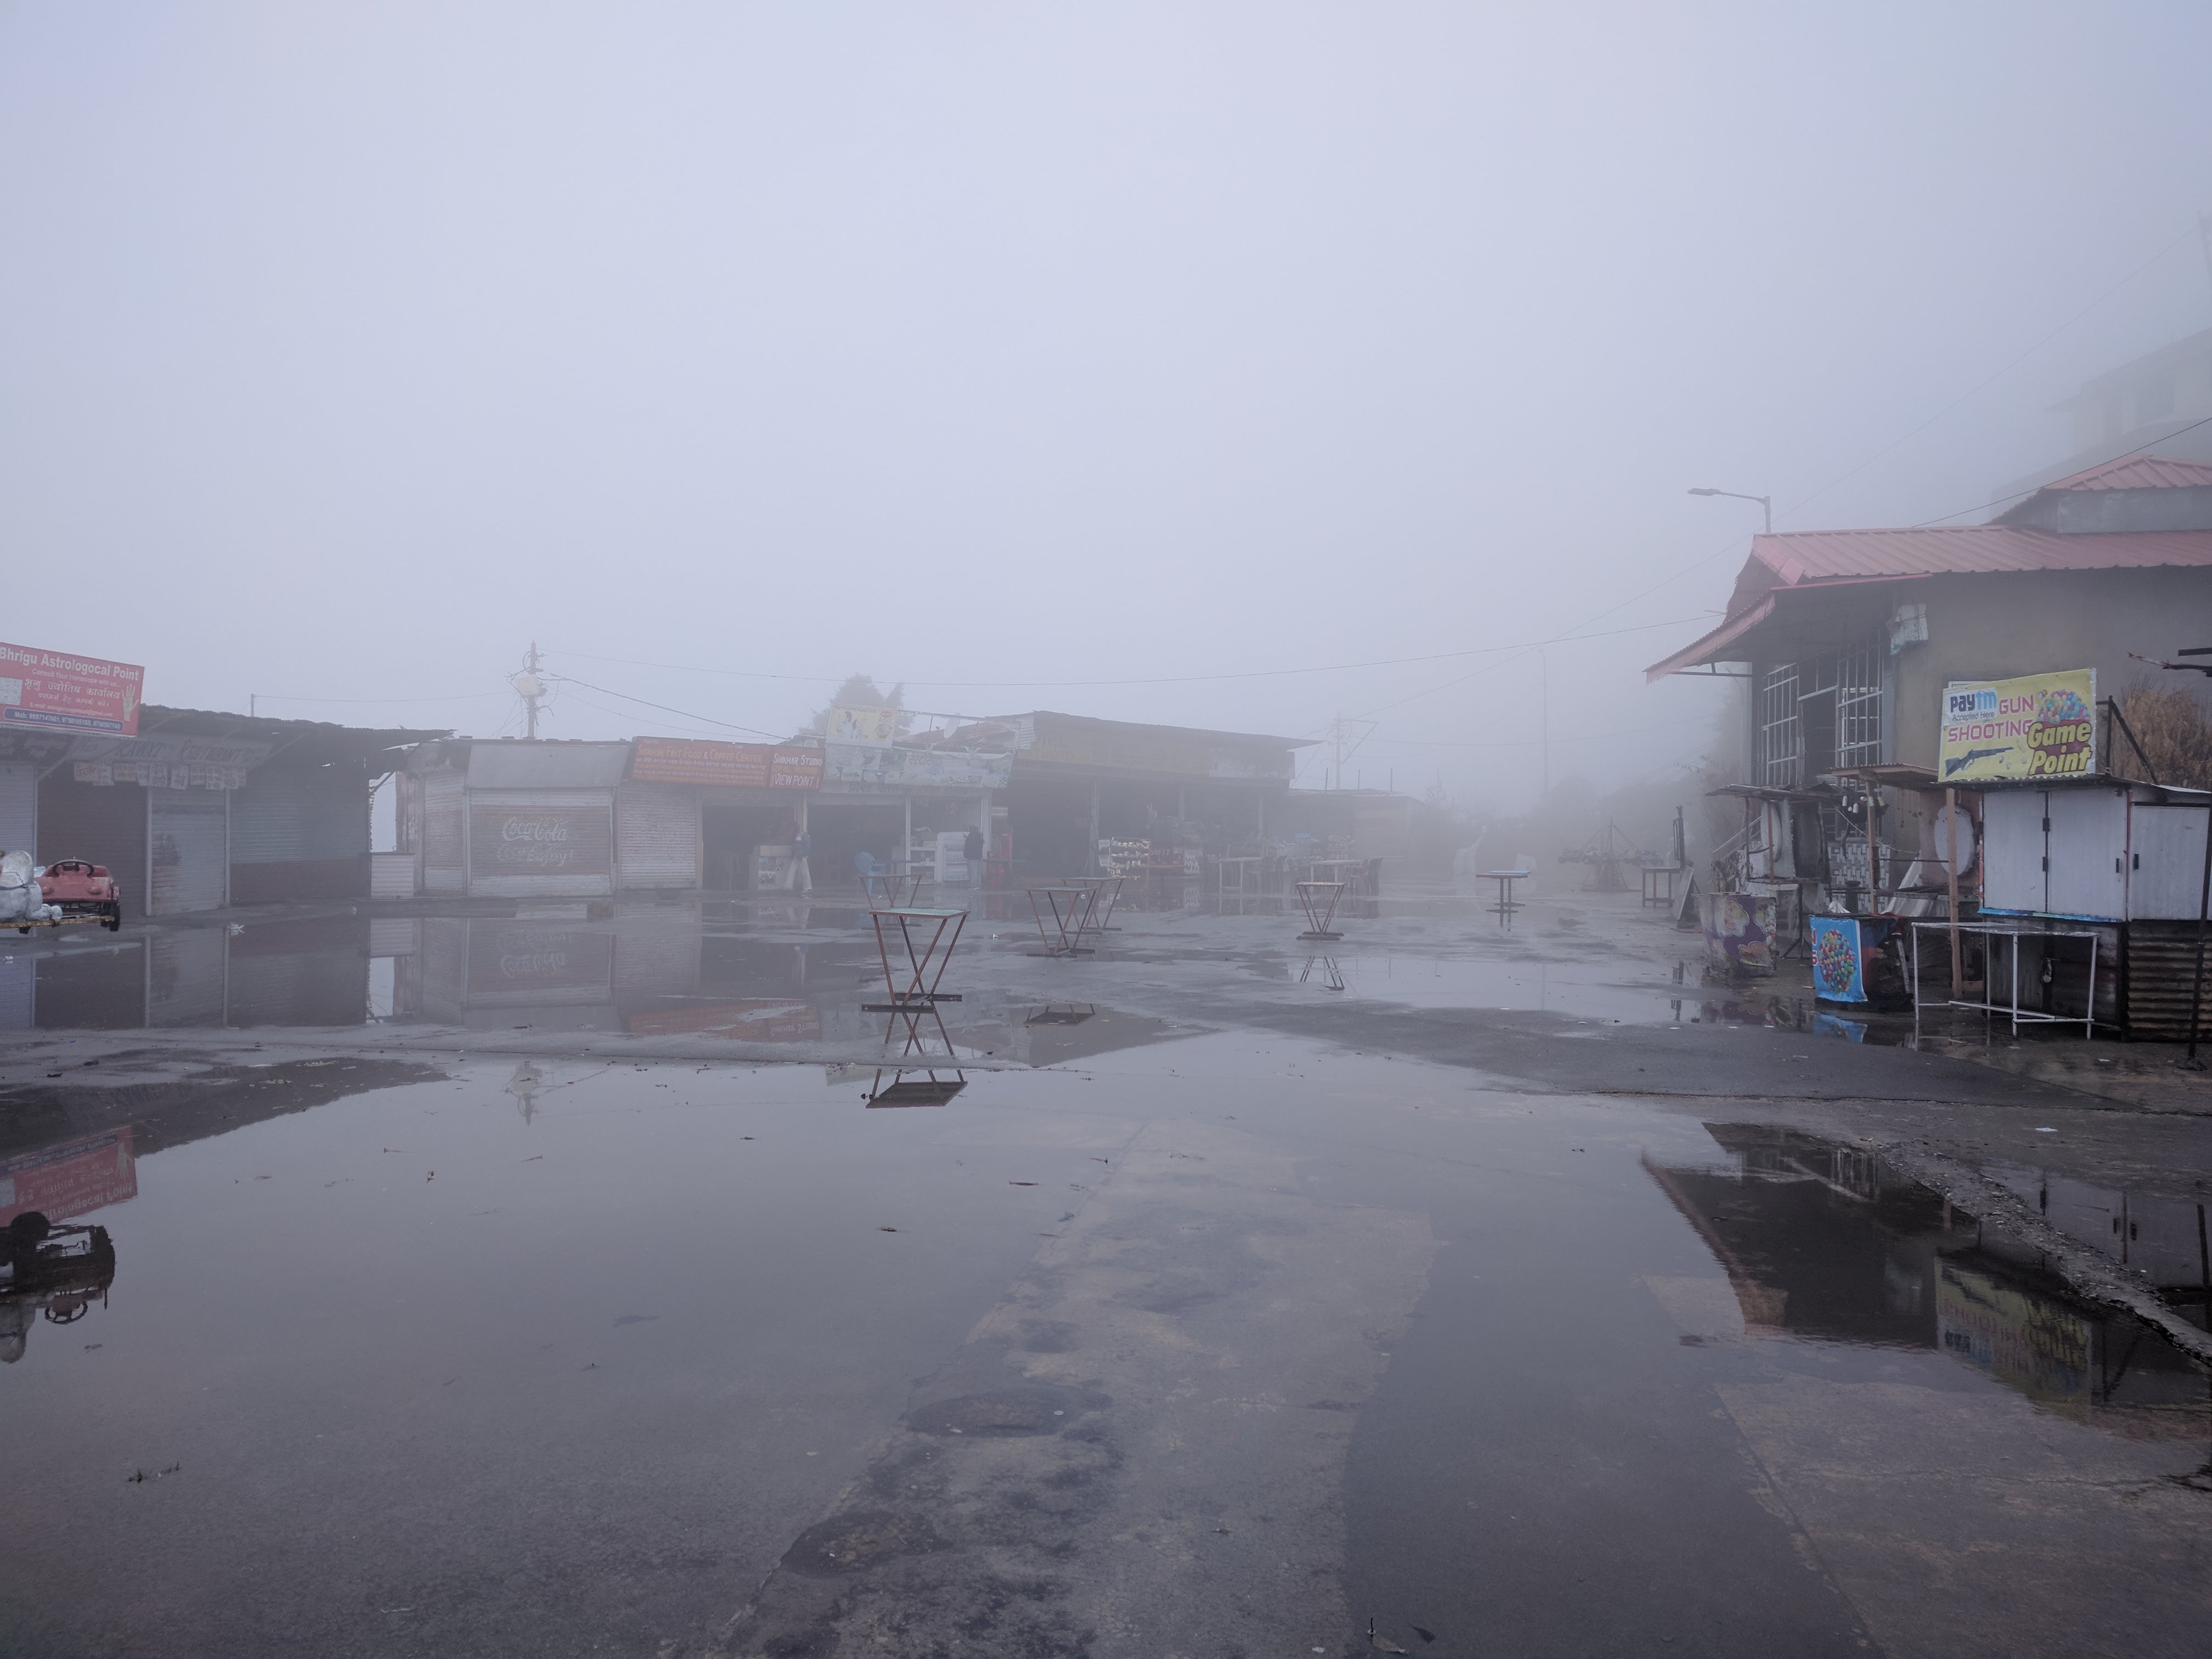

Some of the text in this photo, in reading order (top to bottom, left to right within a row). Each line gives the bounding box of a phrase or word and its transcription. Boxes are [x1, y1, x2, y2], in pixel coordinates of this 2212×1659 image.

[0, 647, 139, 681] Bhrigu Astrologocal Point
[32, 668, 55, 678] Consult
[69, 674, 98, 684] Horoscope
[25, 678, 121, 699] भृगु ज्योतिष कार्यालय
[1950, 691, 1997, 713] paytm
[1999, 693, 2034, 715] GUN
[1952, 710, 1995, 722] Accepted Here
[1948, 719, 2033, 743] SHOOTING
[2027, 721, 2092, 750] Game
[667, 746, 684, 758] FAST
[684, 747, 703, 758] FOOD
[703, 752, 709, 760] &
[710, 748, 735, 761] COFFEE
[736, 751, 763, 763] CENTER
[773, 753, 799, 766] SHIKHAR
[800, 754, 822, 766] STUDIO
[2028, 744, 2092, 776] Point
[775, 772, 793, 786] VIEW
[793, 775, 816, 787] POINT
